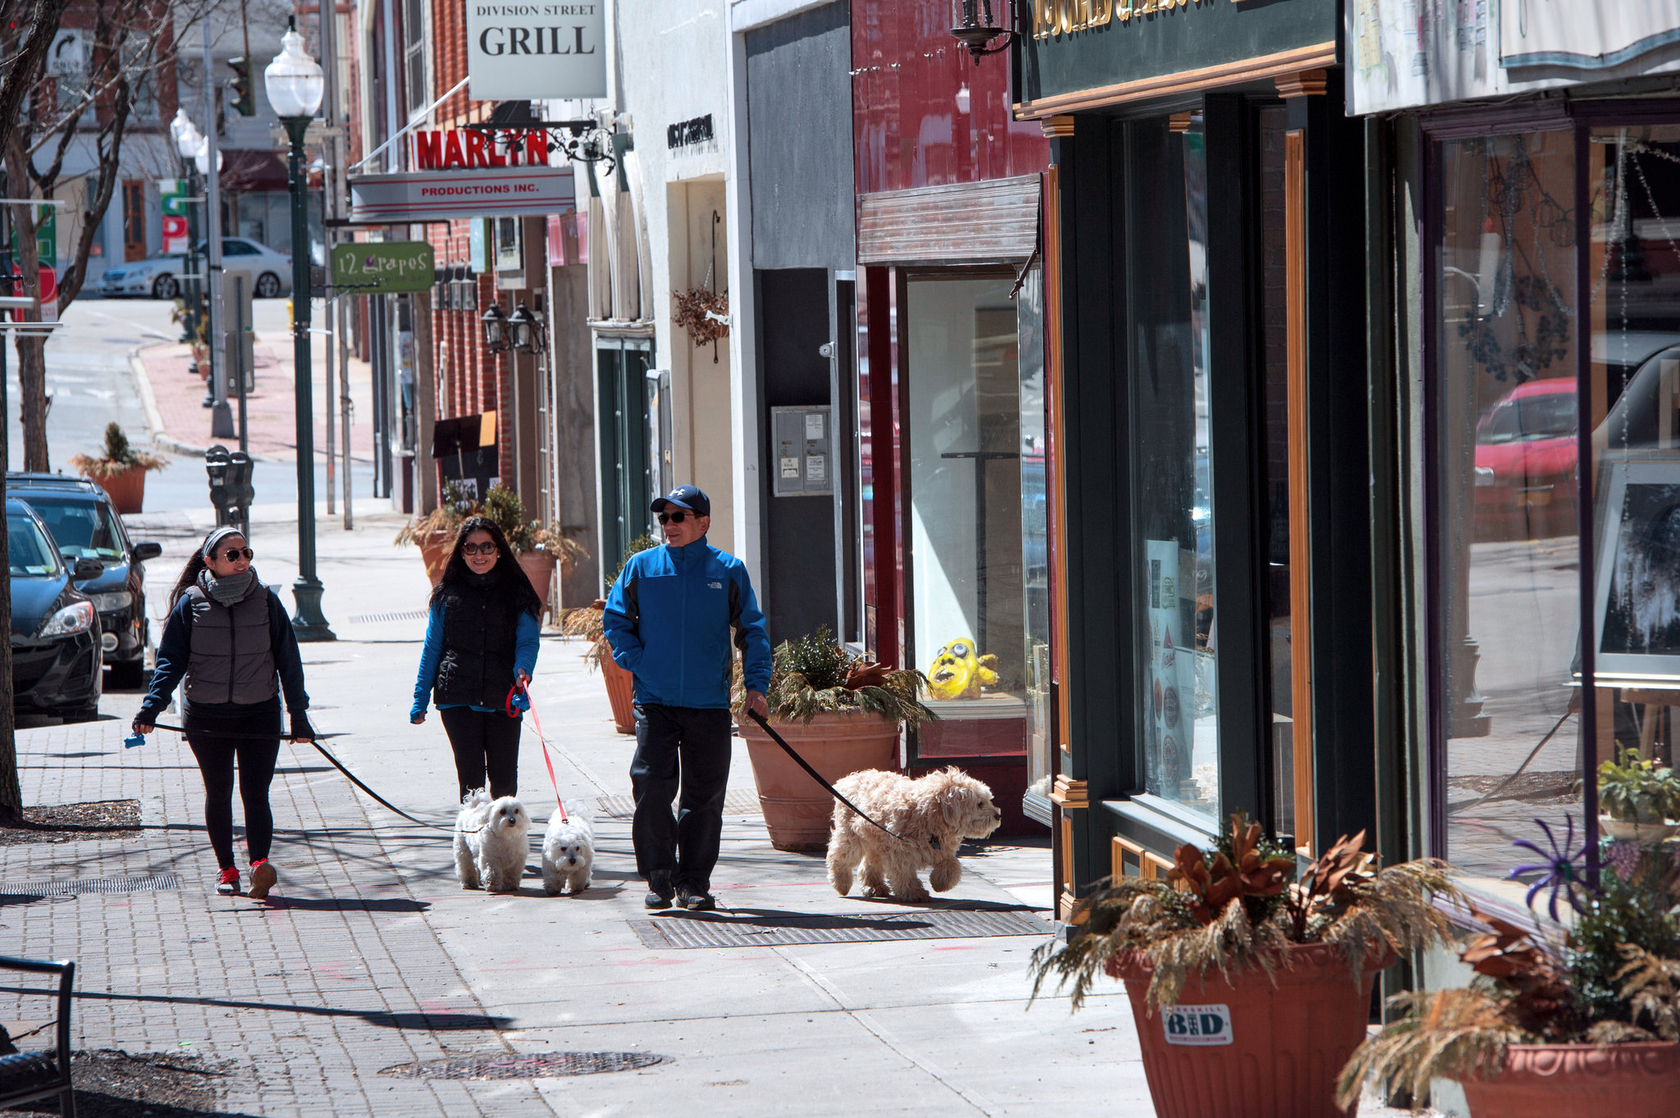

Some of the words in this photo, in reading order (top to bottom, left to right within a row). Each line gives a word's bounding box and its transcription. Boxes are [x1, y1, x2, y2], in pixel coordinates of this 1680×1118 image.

[477, 5, 539, 16] DIVISION
[544, 4, 596, 16] STREET
[479, 26, 596, 56] GRILL
[416, 128, 548, 169] MARLYN
[421, 185, 510, 196] PRODUCTIONS
[514, 183, 540, 193] INC.
[339, 252, 358, 275] 12
[362, 252, 427, 276] grapes
